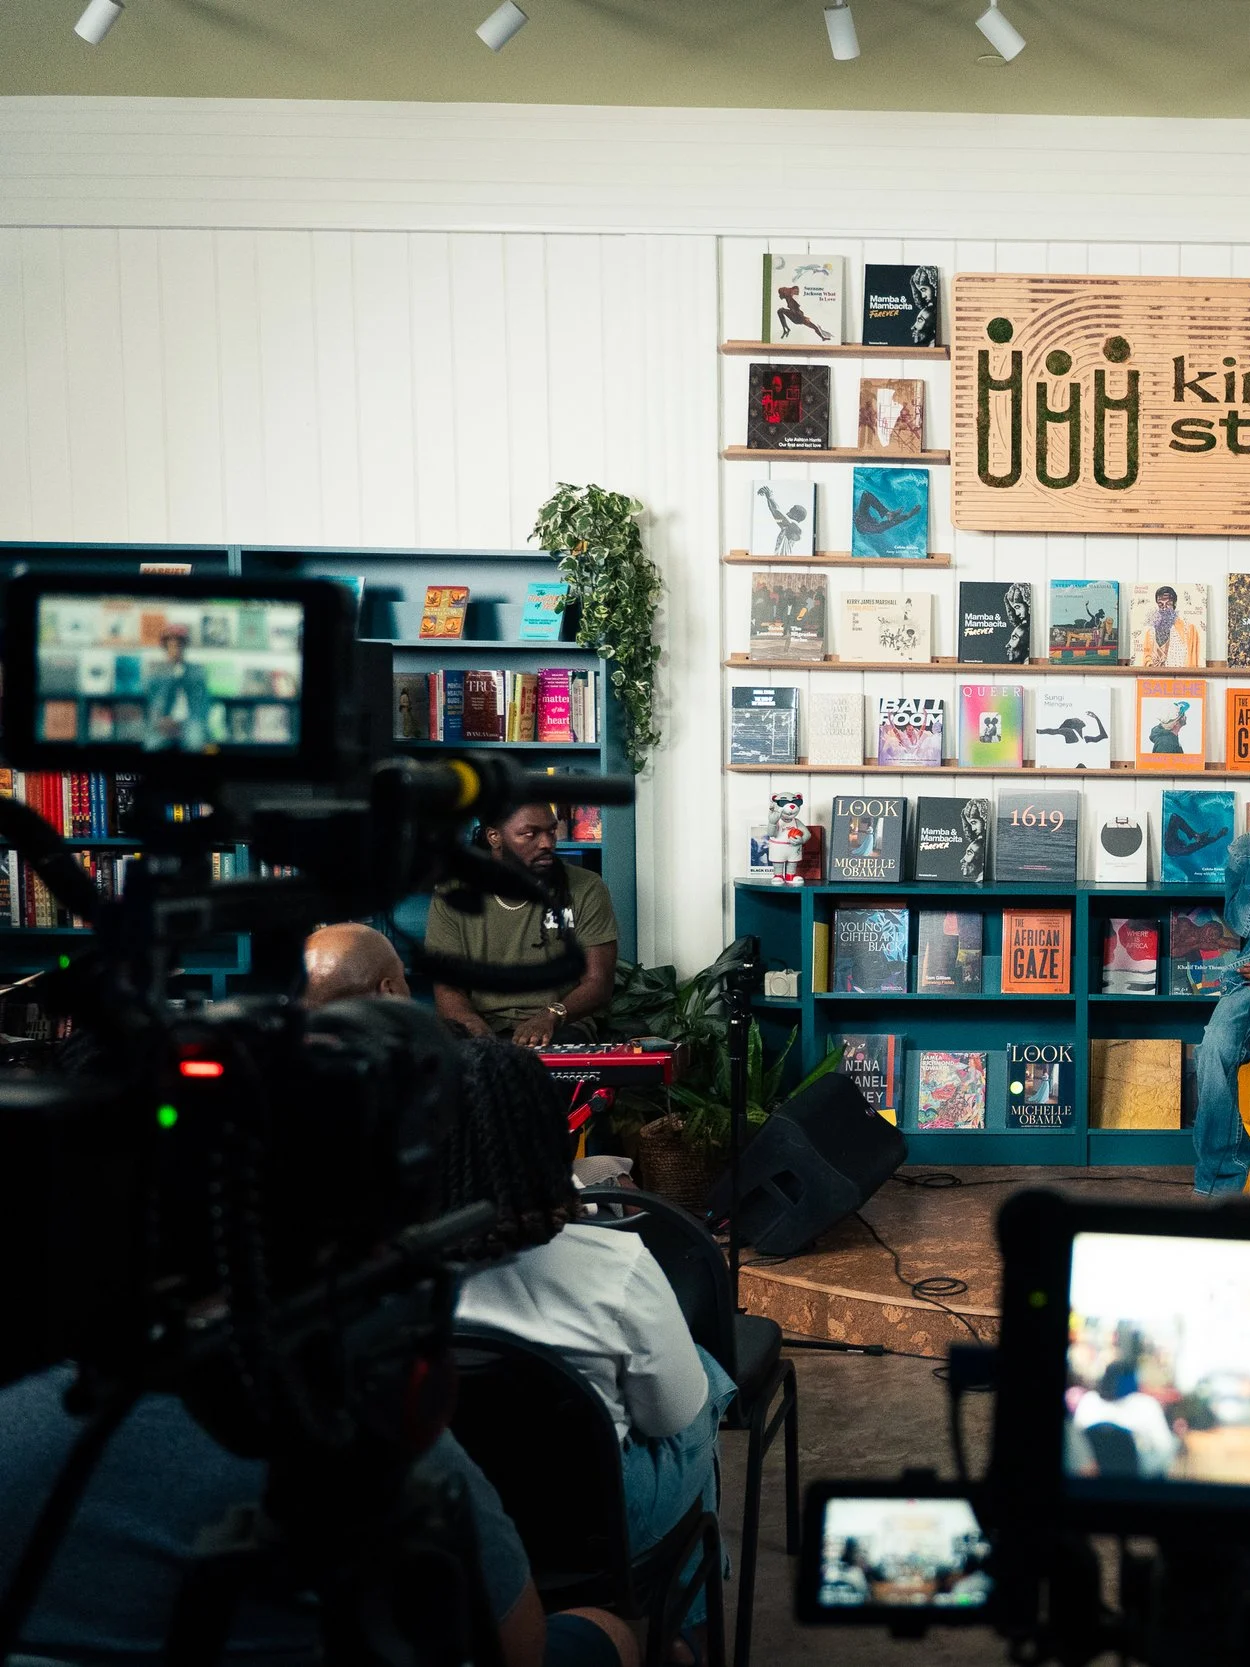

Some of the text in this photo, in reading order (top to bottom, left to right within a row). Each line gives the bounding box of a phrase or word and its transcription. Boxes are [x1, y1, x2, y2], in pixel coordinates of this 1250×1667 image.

[870, 295, 907, 303] Mamba &
[870, 302, 913, 311] Mambacita
[964, 613, 1001, 621] Mamba &
[964, 620, 1007, 628] Mambacita
[466, 680, 498, 692] TRUS
[1142, 682, 1202, 696] SALEHE
[962, 686, 1021, 698] QUEER
[1044, 694, 1065, 703] Sungi
[1238, 698, 1248, 707] THE
[880, 698, 944, 713] BALL
[880, 713, 943, 726] ROOM
[837, 800, 898, 818] LOOK
[1010, 804, 1064, 832] 1619
[921, 828, 958, 836] Mamba &
[920, 834, 963, 844] Mambacita
[834, 858, 896, 870] MICHELLE
[842, 868, 886, 878] OBAMA
[840, 922, 882, 933] YOUNG
[1014, 918, 1024, 928] THE
[840, 932, 905, 942] GIFTED AND
[1014, 930, 1060, 947] AFRICAN
[868, 942, 903, 952] BLACK
[1126, 942, 1149, 950] AFRICA
[1014, 948, 1060, 979] GAZE
[1012, 1045, 1073, 1063] LOOK
[846, 1060, 880, 1072] NINA
[1011, 1106, 1072, 1116] MICHELLE
[1018, 1115, 1062, 1125] OBAMA
